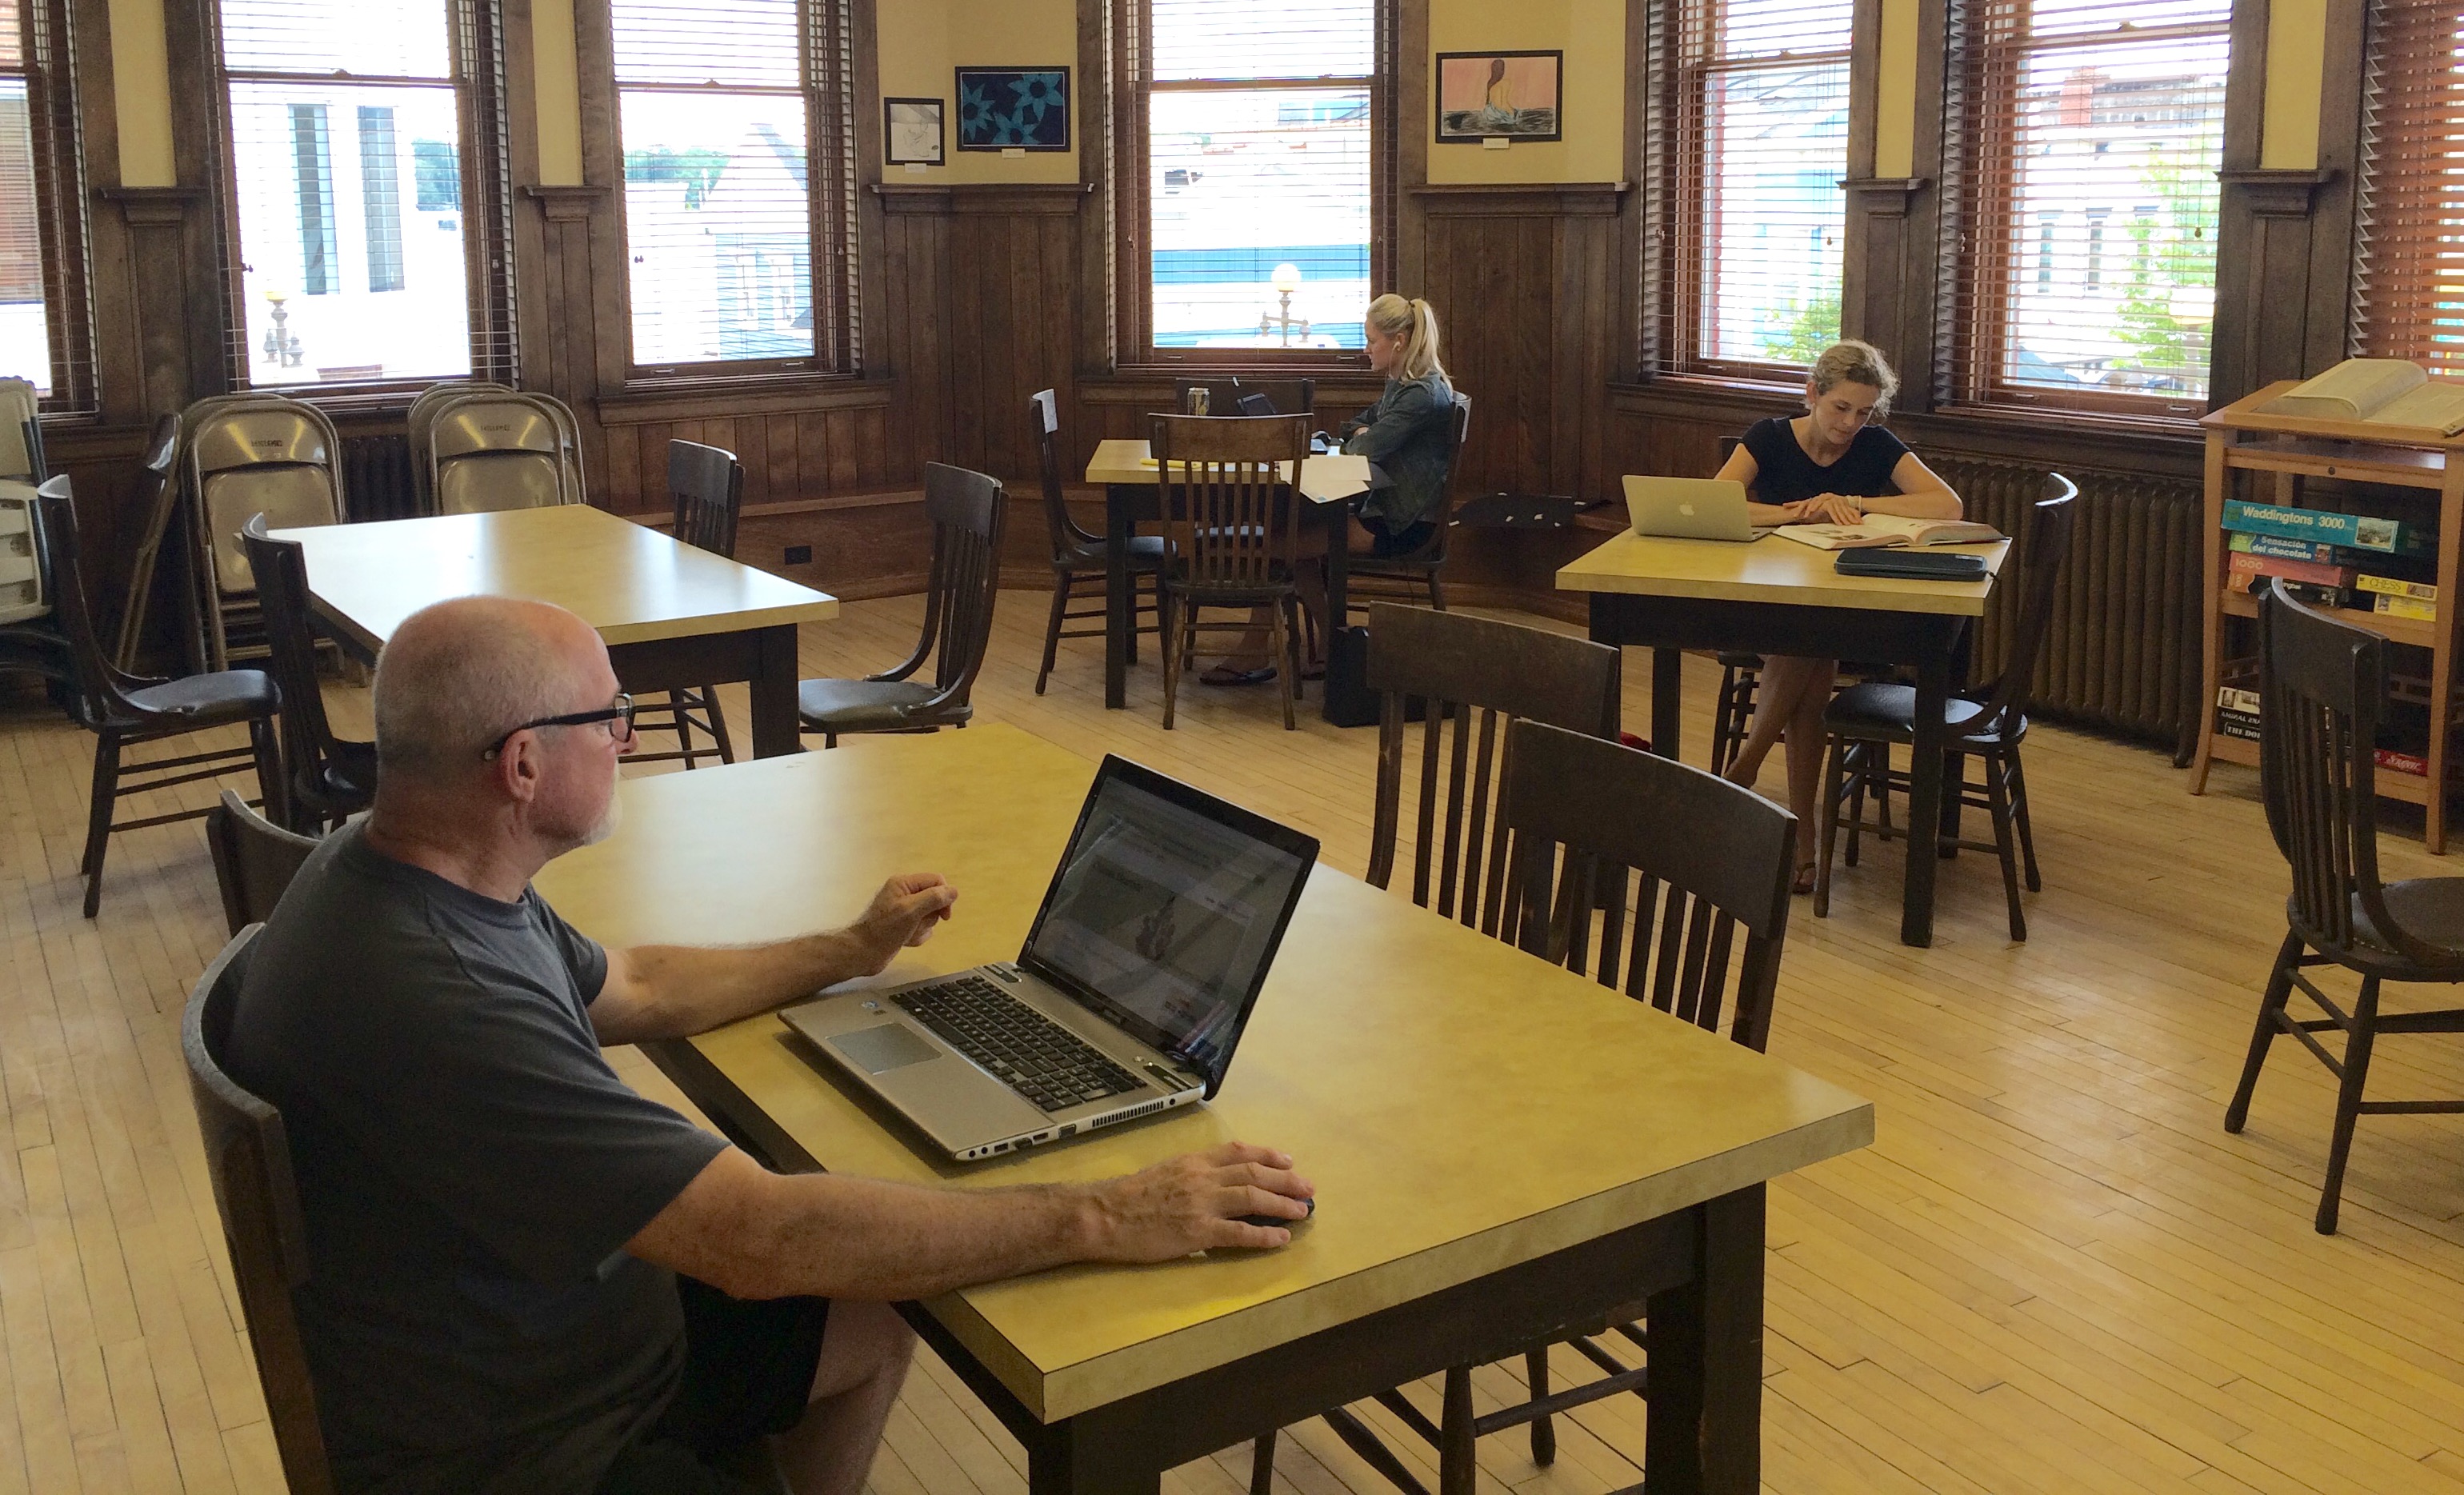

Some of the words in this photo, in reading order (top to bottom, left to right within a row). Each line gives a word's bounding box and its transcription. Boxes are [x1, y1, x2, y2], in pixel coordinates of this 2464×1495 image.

[2243, 506, 2314, 526] Waddingtons
[2318, 515, 2346, 530] 3000
[2252, 544, 2266, 553] del
[2267, 546, 2312, 559] chocolate
[2235, 558, 2263, 570] 1000
[2370, 578, 2402, 591] CHESS
